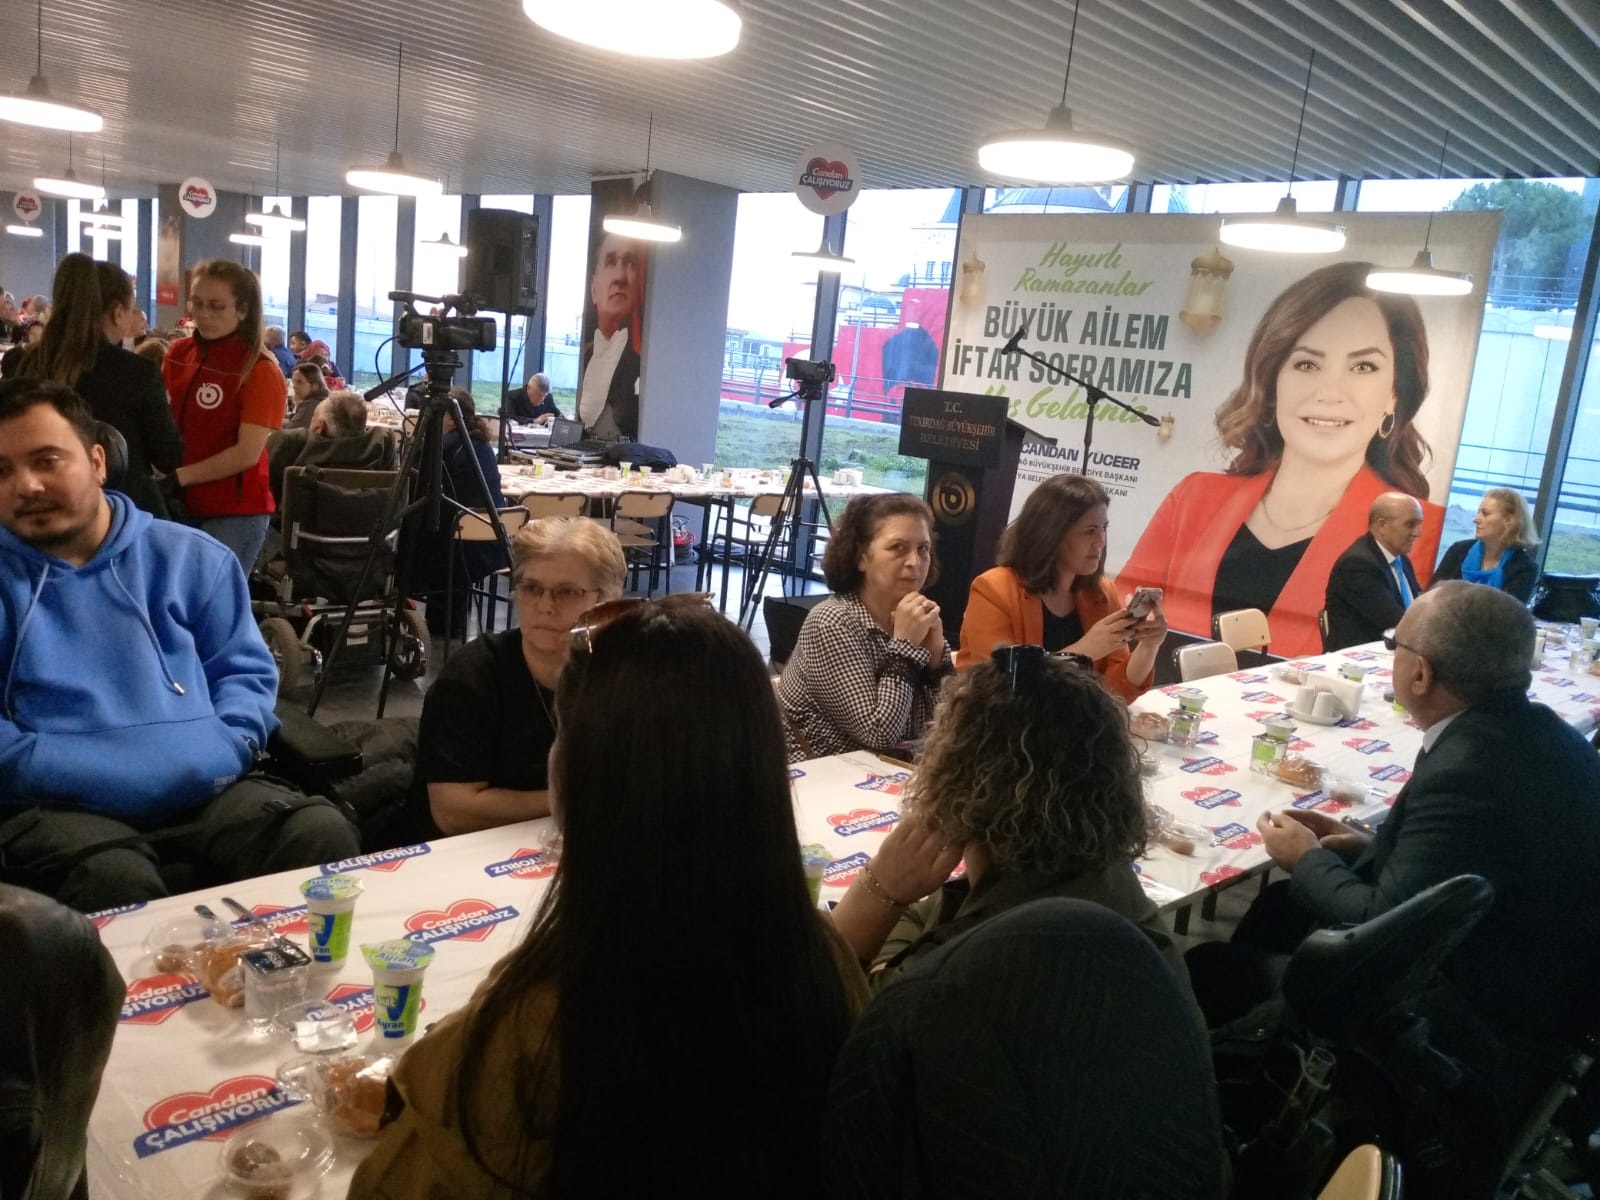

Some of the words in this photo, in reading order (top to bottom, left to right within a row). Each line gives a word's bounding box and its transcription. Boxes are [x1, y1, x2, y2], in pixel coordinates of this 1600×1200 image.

[802, 175, 850, 190] ÇALIŞIYORUZ
[812, 167, 843, 179] Candan
[1038, 241, 1122, 277] Hayırlı
[1013, 267, 1152, 296] Ramazanlar
[984, 300, 1073, 343] BÜYÜK
[1079, 305, 1169, 350] AİLEM
[951, 338, 1022, 381] İFTAR
[1029, 350, 1193, 398] SOFRAMIZA
[1020, 442, 1079, 462] CANDAN
[1071, 467, 1103, 480] BEDİYE
[1104, 471, 1138, 484] BAŞKANI
[326, 844, 425, 873] ÇALIŞIYORUZ
[409, 909, 515, 943] ÇALIŞIYORUZ
[421, 908, 489, 931] Candan
[125, 982, 183, 1003] ndan
[145, 1091, 294, 1149] ÇALIŞIYORU
[168, 1086, 268, 1126] Candan
